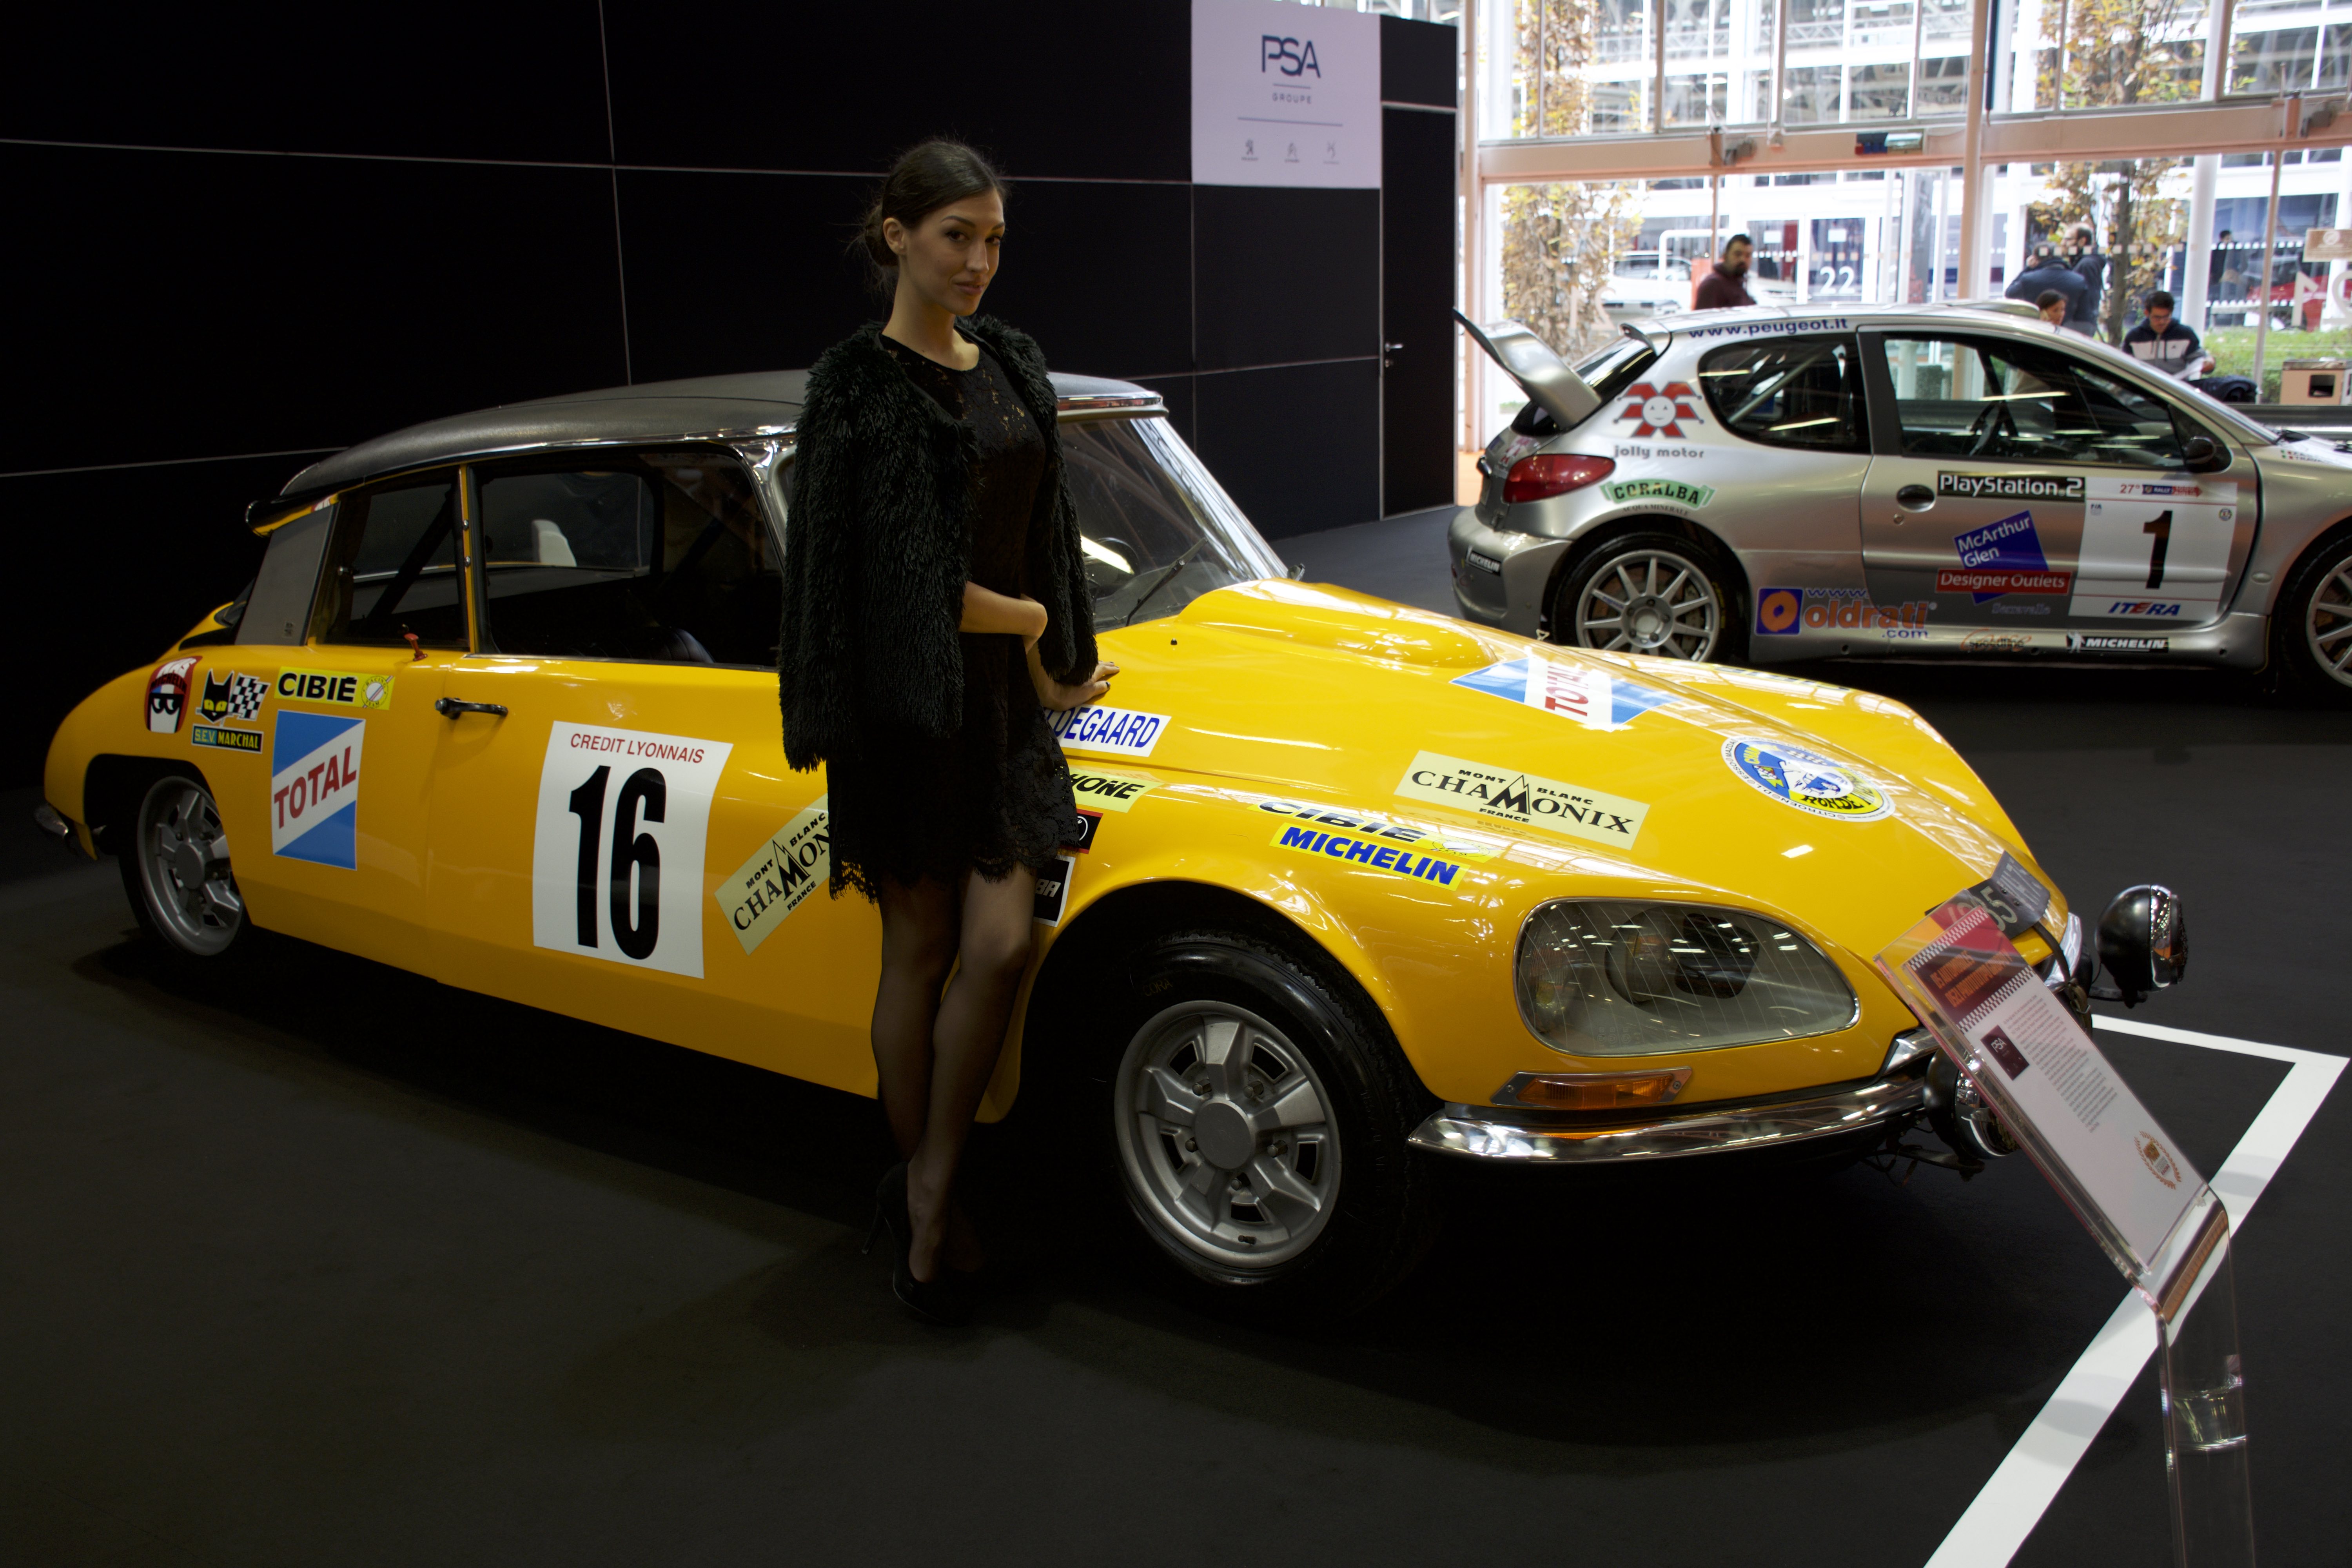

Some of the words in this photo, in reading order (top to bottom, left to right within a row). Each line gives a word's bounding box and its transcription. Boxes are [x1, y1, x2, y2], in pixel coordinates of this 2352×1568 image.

[1261, 34, 1321, 78] PSA
[1272, 93, 1312, 105] GROUPE
[1819, 266, 1855, 294] 22
[1688, 318, 1848, 338] www.peugeot.it
[1613, 445, 1651, 459] jolly
[1657, 447, 1704, 458] motor
[1613, 483, 1699, 505] CORALBA
[1958, 516, 2031, 552] McArthur
[1964, 547, 2000, 568] Glen
[2143, 510, 2173, 589] 1
[1940, 572, 2007, 591] Designer
[2011, 572, 2065, 589] Outlets
[1805, 600, 1928, 629] oldrati
[2108, 601, 2181, 616] ITERA
[2085, 638, 2165, 650] MICHELIN
[150, 673, 187, 695] MICHELIN
[217, 730, 259, 750] MARCHAL
[570, 733, 625, 754] CREDIT
[626, 740, 705, 764] LYONNAIS
[273, 746, 357, 829] TOTAL
[1069, 773, 1147, 800] HONE
[1458, 769, 1507, 784] MONT
[1536, 787, 1593, 805] BLANC
[1411, 771, 1634, 834] CHAMONIX
[1479, 808, 1530, 823] FRANCE
[1801, 795, 1865, 809] RONDE
[569, 765, 667, 960] 16
[746, 858, 774, 889] MONT
[789, 812, 826, 847] BLANC
[1279, 826, 1460, 886] MICHELIN
[733, 824, 831, 931] CHAMON
[786, 882, 817, 911] FRANCE
[1991, 1037, 2007, 1053] PSA
